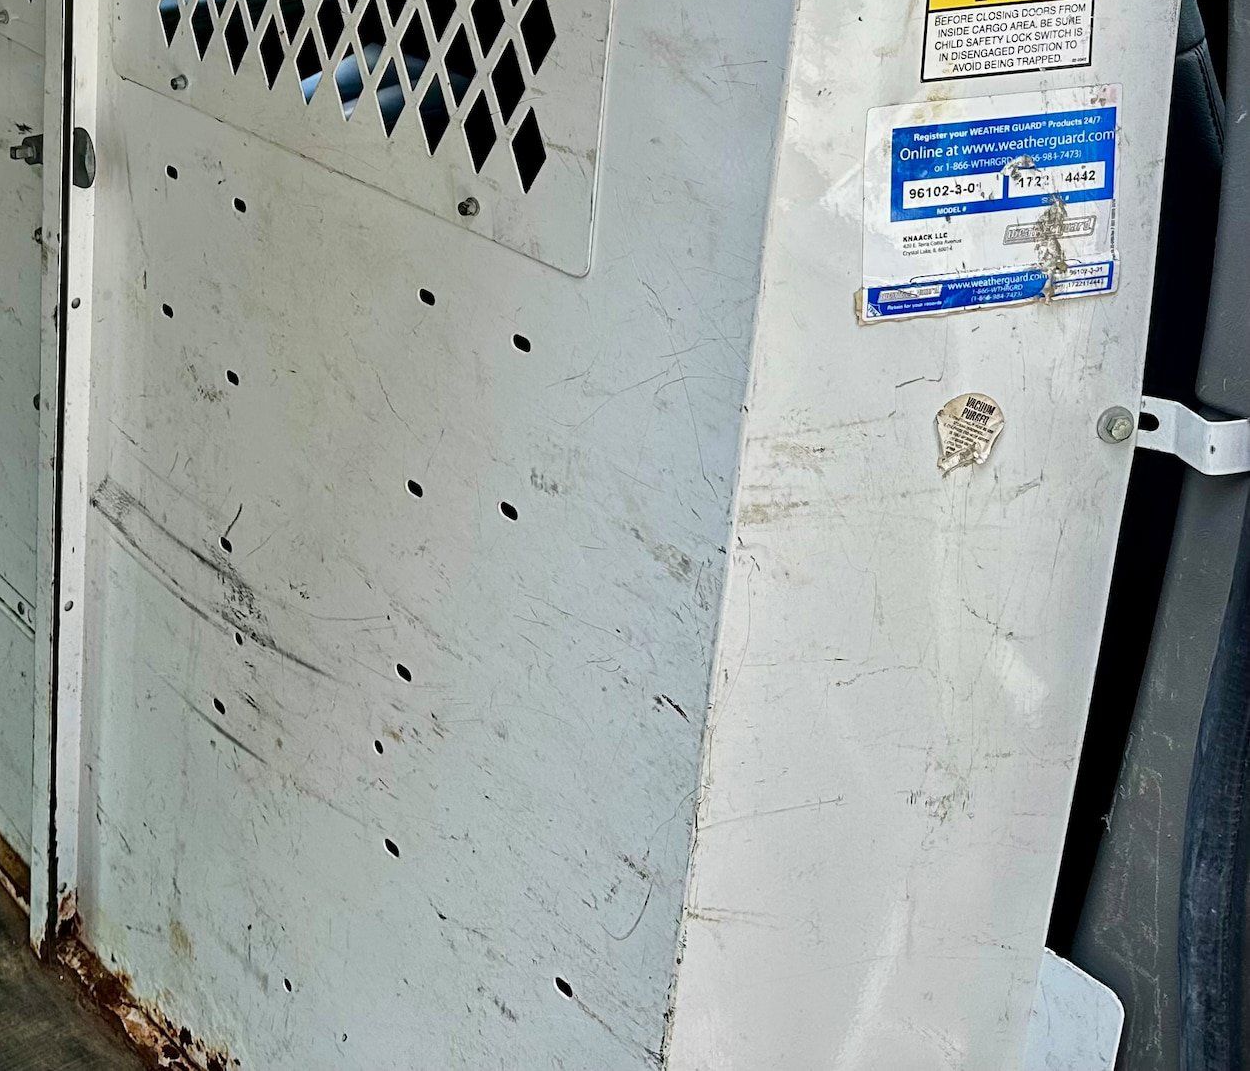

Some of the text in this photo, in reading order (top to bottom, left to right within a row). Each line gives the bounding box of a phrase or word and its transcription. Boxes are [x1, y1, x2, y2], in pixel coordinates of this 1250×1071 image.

[935, 3, 1086, 26] BEFORE CLOSING DOORS FROM
[938, 26, 970, 38] INSIDE
[972, 23, 1008, 35] CARGO
[1040, 18, 1053, 28] BE
[1055, 15, 1082, 27] SURE
[934, 27, 1083, 51] CHILD SAFETY LOCK SWITCH IS
[938, 39, 1078, 62] IN DISENGAGED POSITION TO
[952, 61, 982, 73] AVOID
[984, 58, 1014, 70] BEING
[913, 132, 948, 143] Register
[949, 130, 969, 140] your
[970, 125, 1011, 136] WEATHER
[1048, 118, 1083, 128] Products
[1083, 115, 1101, 125] 24/7
[899, 130, 1115, 161] Online at www.weatherguard.com
[934, 165, 944, 173] or
[936, 206, 961, 216] MODEL
[902, 232, 948, 243] KNAACK LLC
[947, 273, 1048, 291] www.weatherguard.com
[965, 396, 996, 416] VACUUM
